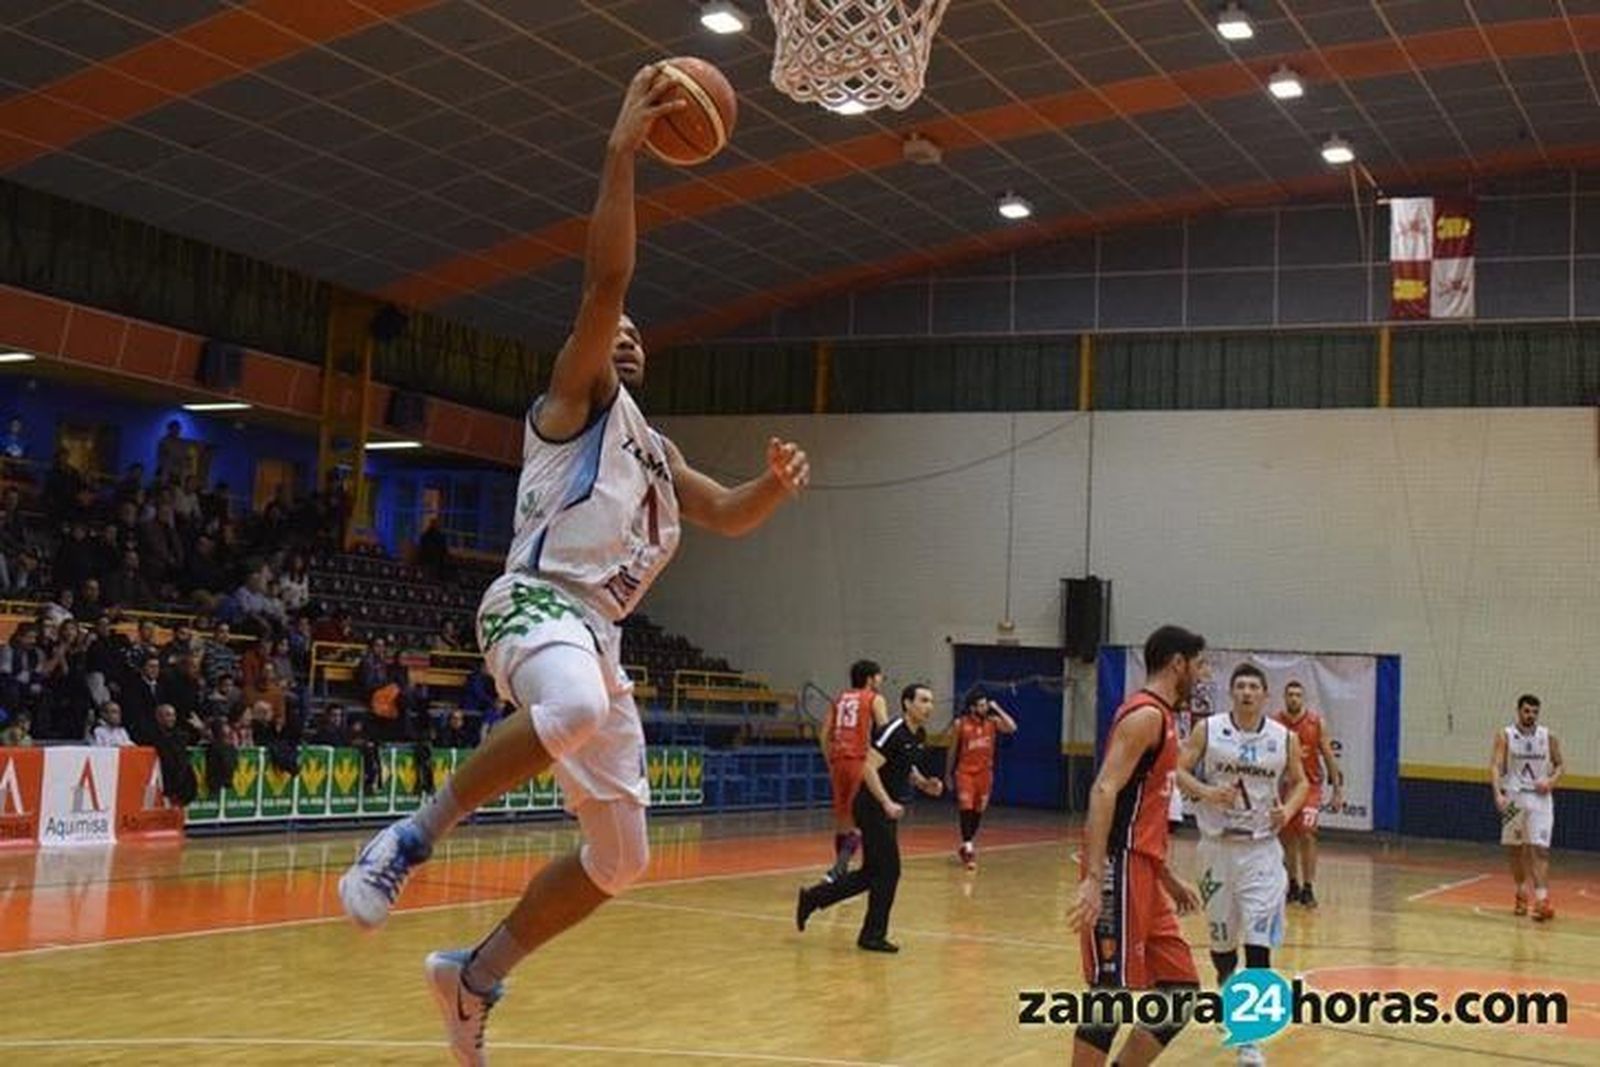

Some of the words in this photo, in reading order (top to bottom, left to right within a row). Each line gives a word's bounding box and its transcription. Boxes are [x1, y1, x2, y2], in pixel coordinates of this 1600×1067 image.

[836, 699, 860, 728] 13
[1239, 744, 1257, 762] 21
[1209, 921, 1229, 941] 21
